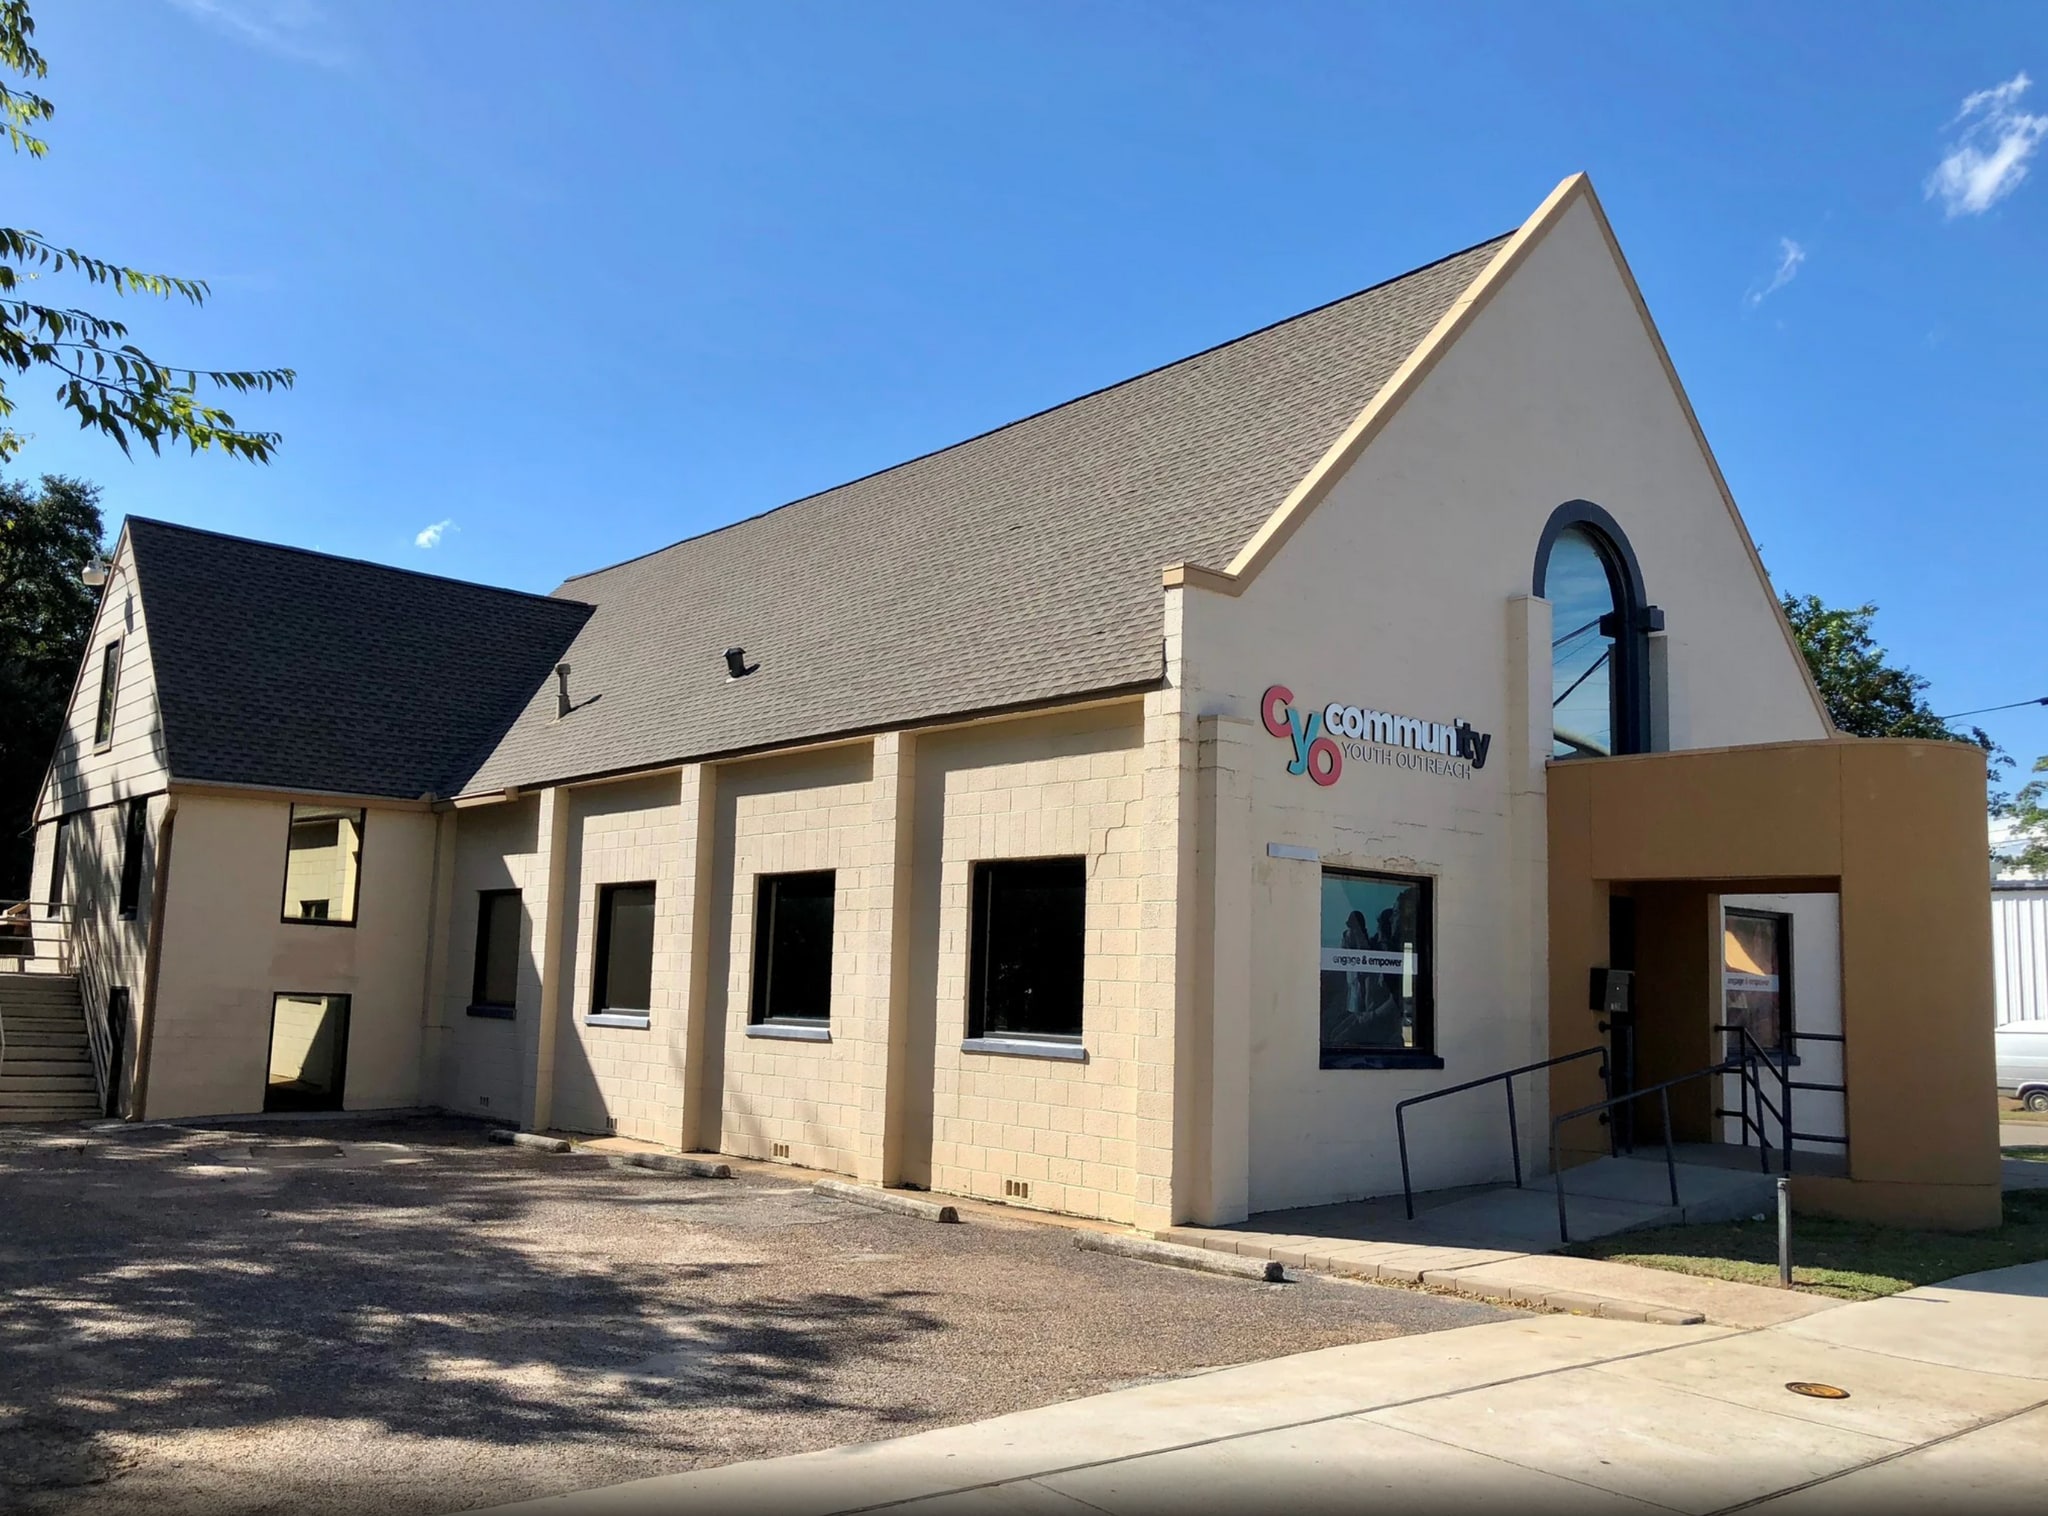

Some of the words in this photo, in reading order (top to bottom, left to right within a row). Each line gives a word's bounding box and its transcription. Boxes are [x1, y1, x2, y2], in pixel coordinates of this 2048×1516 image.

[1323, 702, 1492, 770] community
[1341, 742, 1392, 766] YOUTH
[1395, 751, 1471, 780] OUTREACH
[1332, 955, 1361, 967] engage
[1361, 955, 1368, 965] &
[1368, 957, 1403, 968] empower
